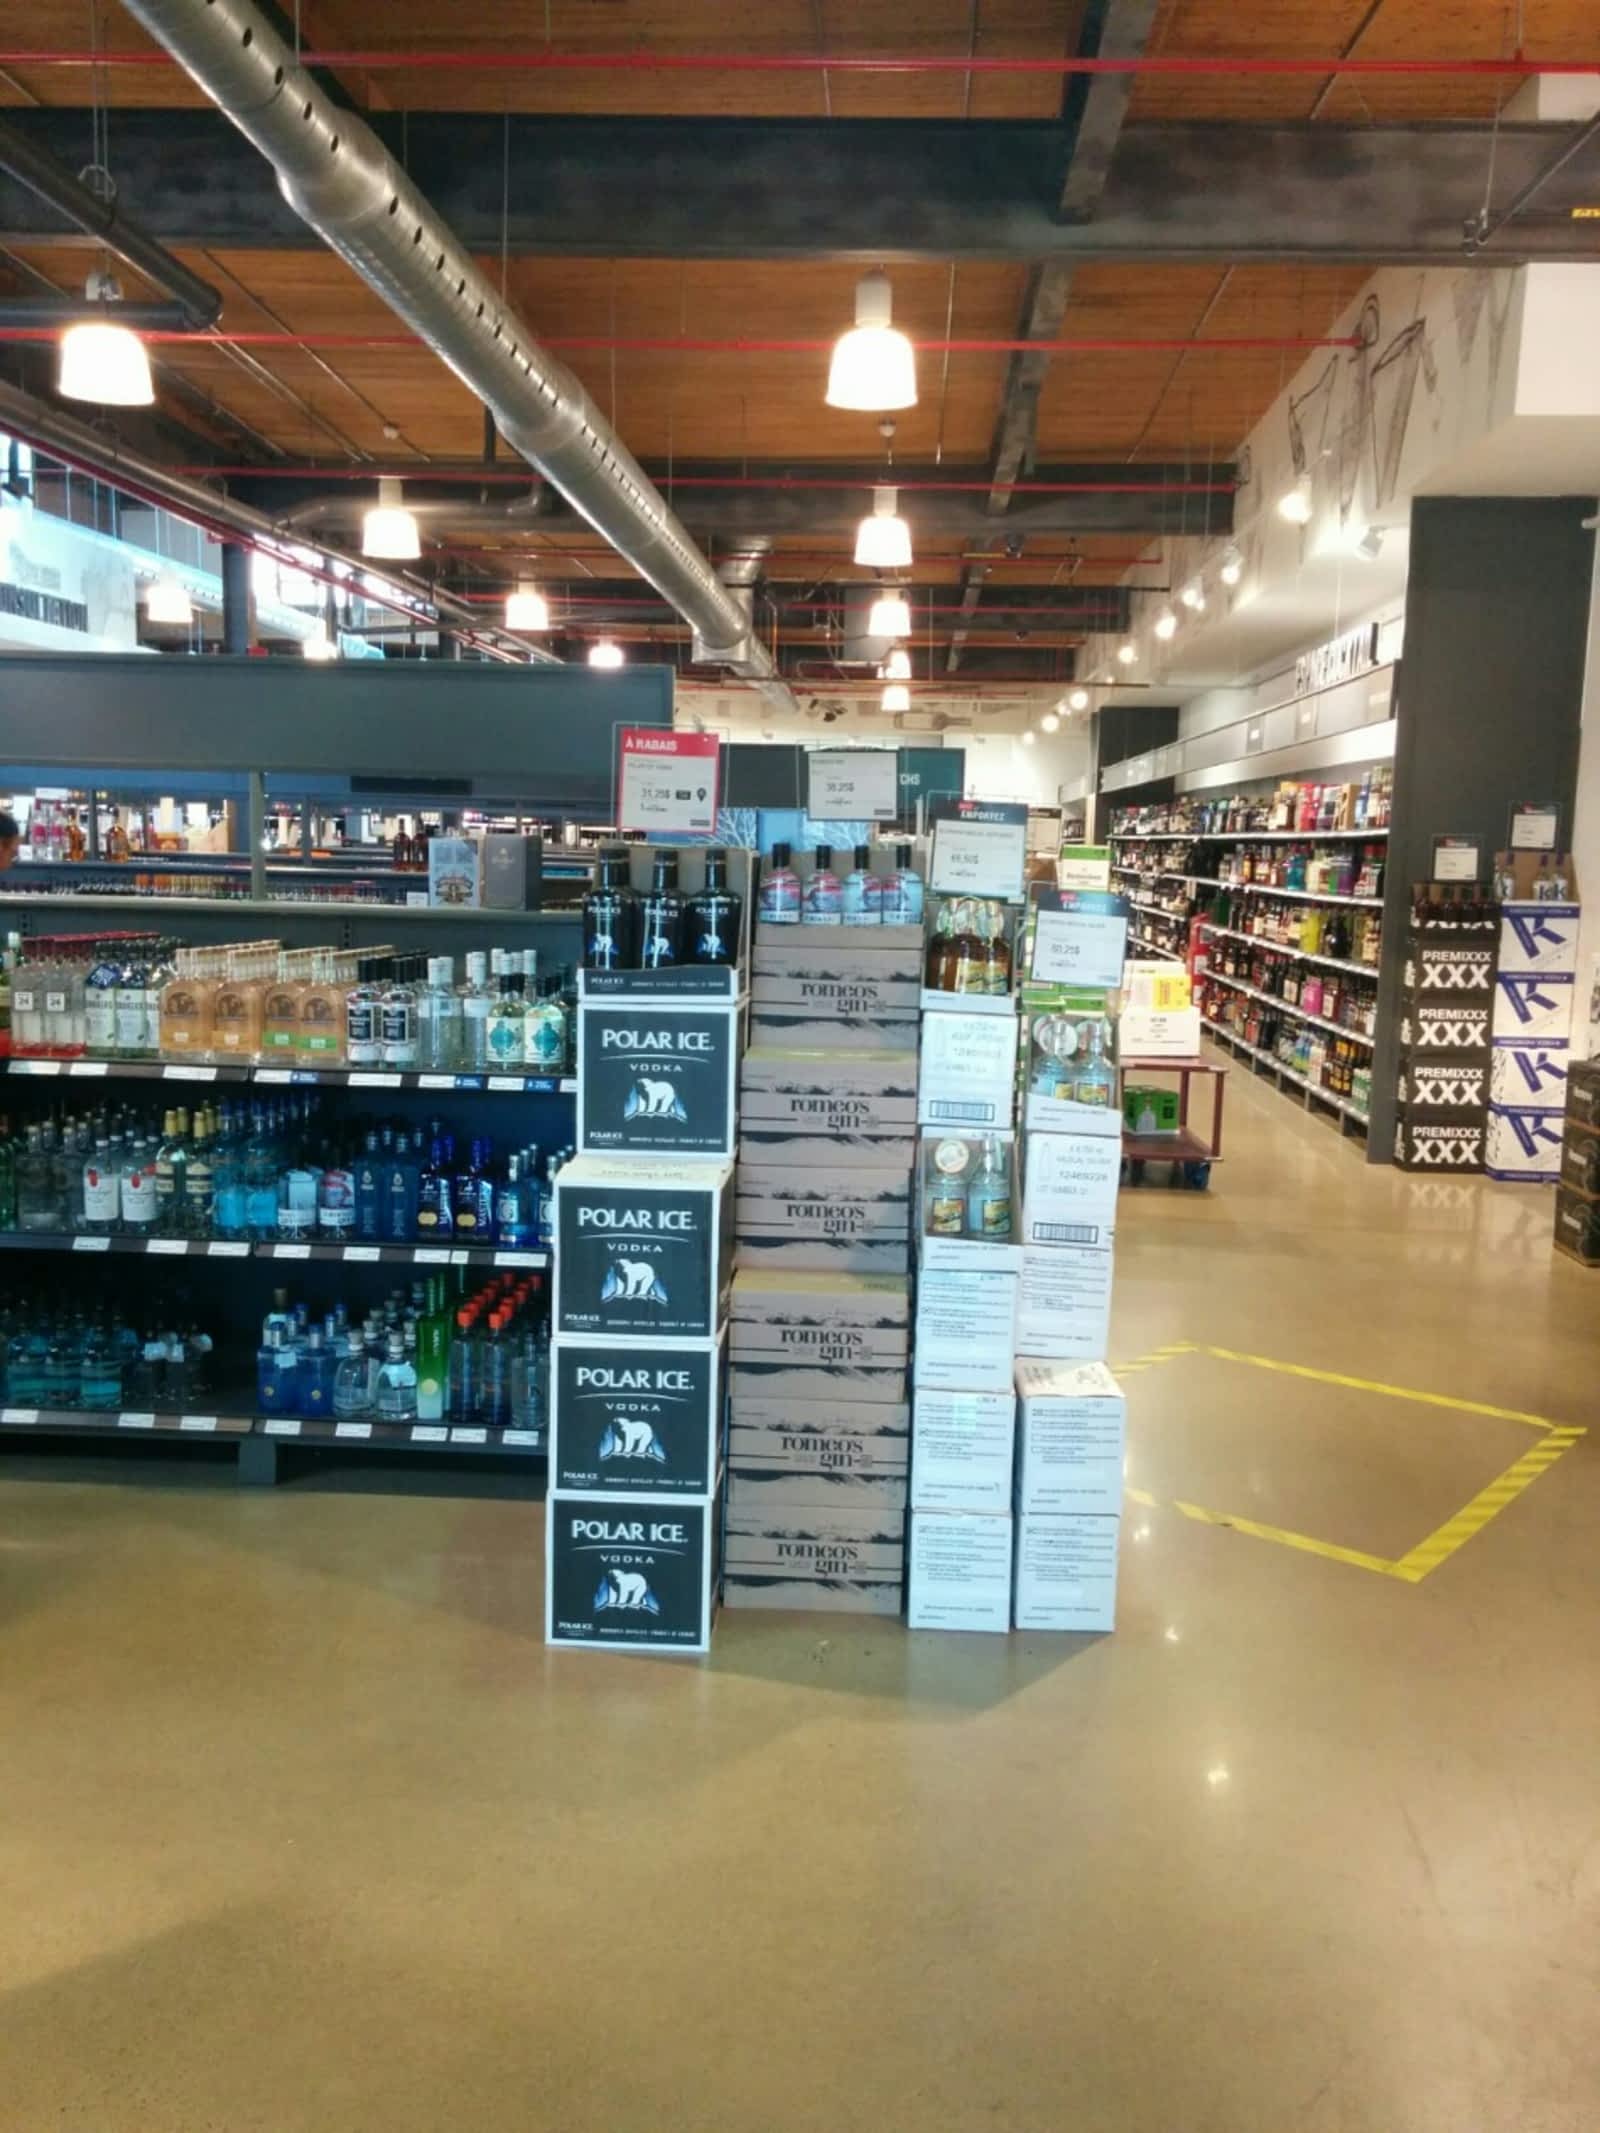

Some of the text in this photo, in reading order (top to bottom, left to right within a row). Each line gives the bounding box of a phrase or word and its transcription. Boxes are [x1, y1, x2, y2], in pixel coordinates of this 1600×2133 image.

[636, 738, 678, 752] RABAIS
[899, 773, 921, 786] CHS
[1422, 950, 1492, 962] PREMIXXX
[1420, 964, 1490, 989] XXX
[837, 1000, 868, 1016] gin
[1418, 1008, 1488, 1020] PREMIXXX
[602, 1028, 674, 1050] POLAR
[1416, 1022, 1486, 1047] XXX
[630, 1063, 683, 1072] VODKA
[1414, 1067, 1484, 1080] PREMIXXX
[1412, 1080, 1482, 1105] XXX
[827, 1115, 860, 1133] gin
[1412, 1126, 1482, 1138] PREMIXXX
[1412, 1139, 1480, 1164] XXX
[578, 1207, 652, 1229] POLAR
[823, 1220, 856, 1238] gin
[607, 1243, 663, 1253] VODKA
[818, 1346, 853, 1365] gin
[576, 1367, 650, 1388] POLAR
[605, 1402, 661, 1412] VODKA
[820, 1454, 852, 1469] gin
[572, 1520, 645, 1542] POLAR
[600, 1554, 655, 1564] VODKA
[814, 1560, 848, 1577] gin
